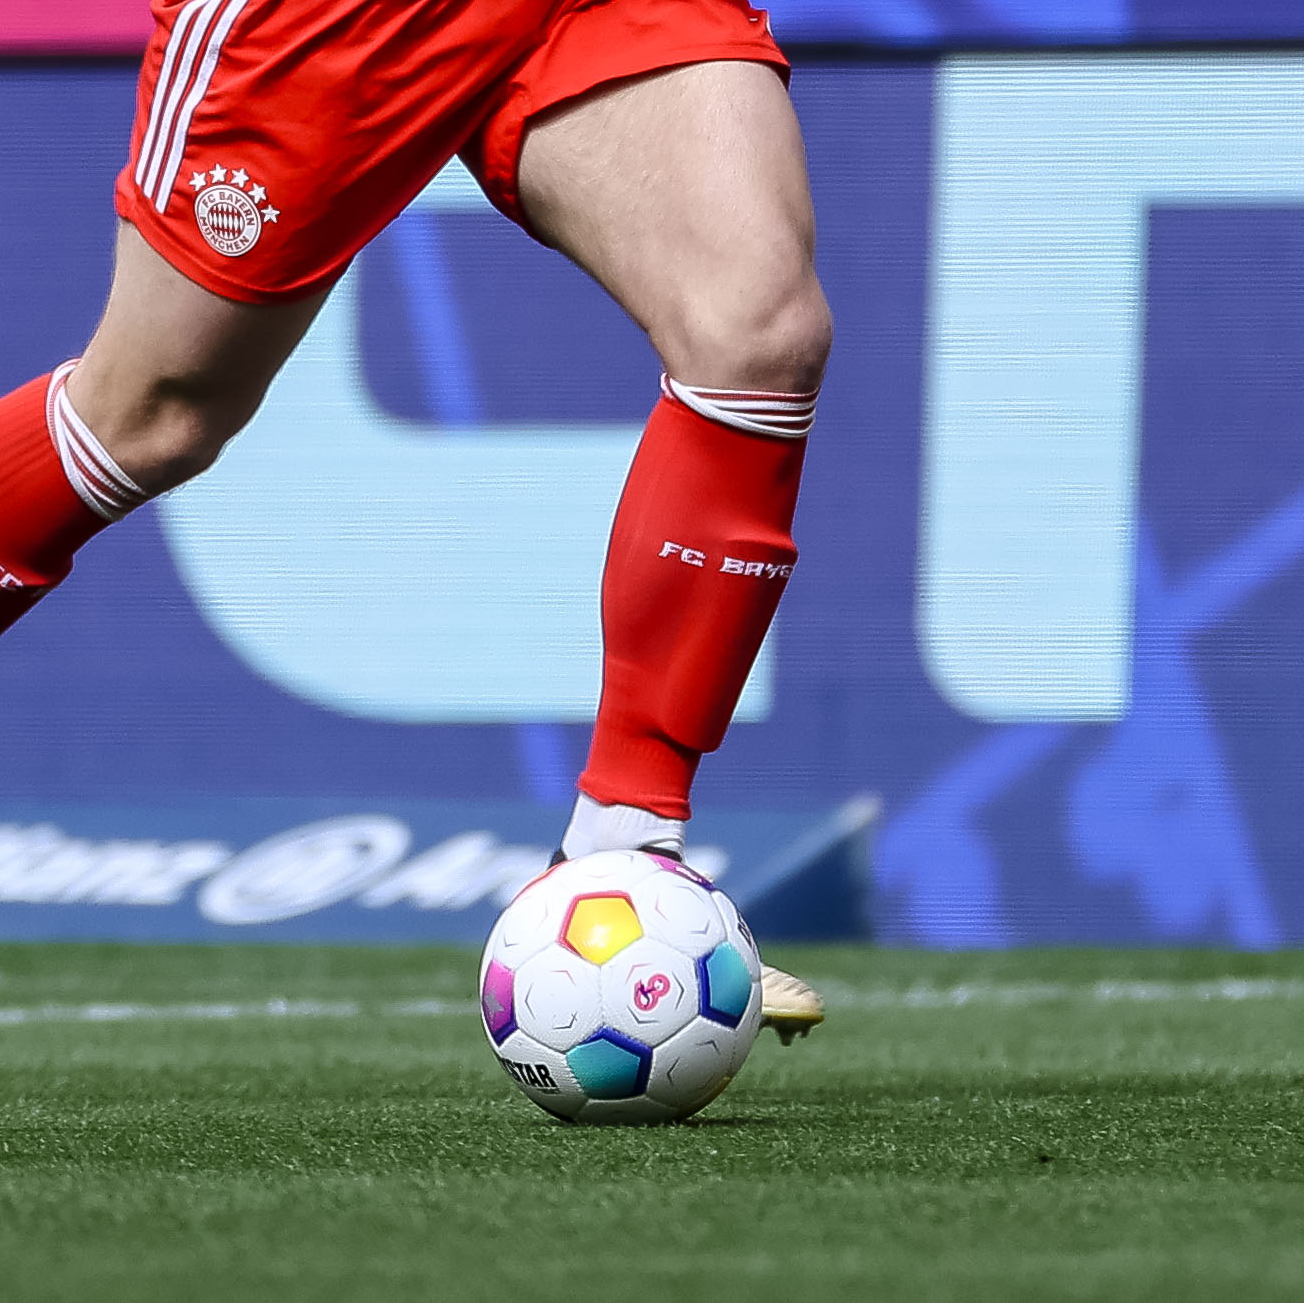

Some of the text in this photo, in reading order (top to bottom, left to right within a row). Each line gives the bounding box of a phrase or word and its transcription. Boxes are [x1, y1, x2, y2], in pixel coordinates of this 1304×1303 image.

[202, 192, 255, 226] FC BAYERN
[658, 540, 706, 568] FC
